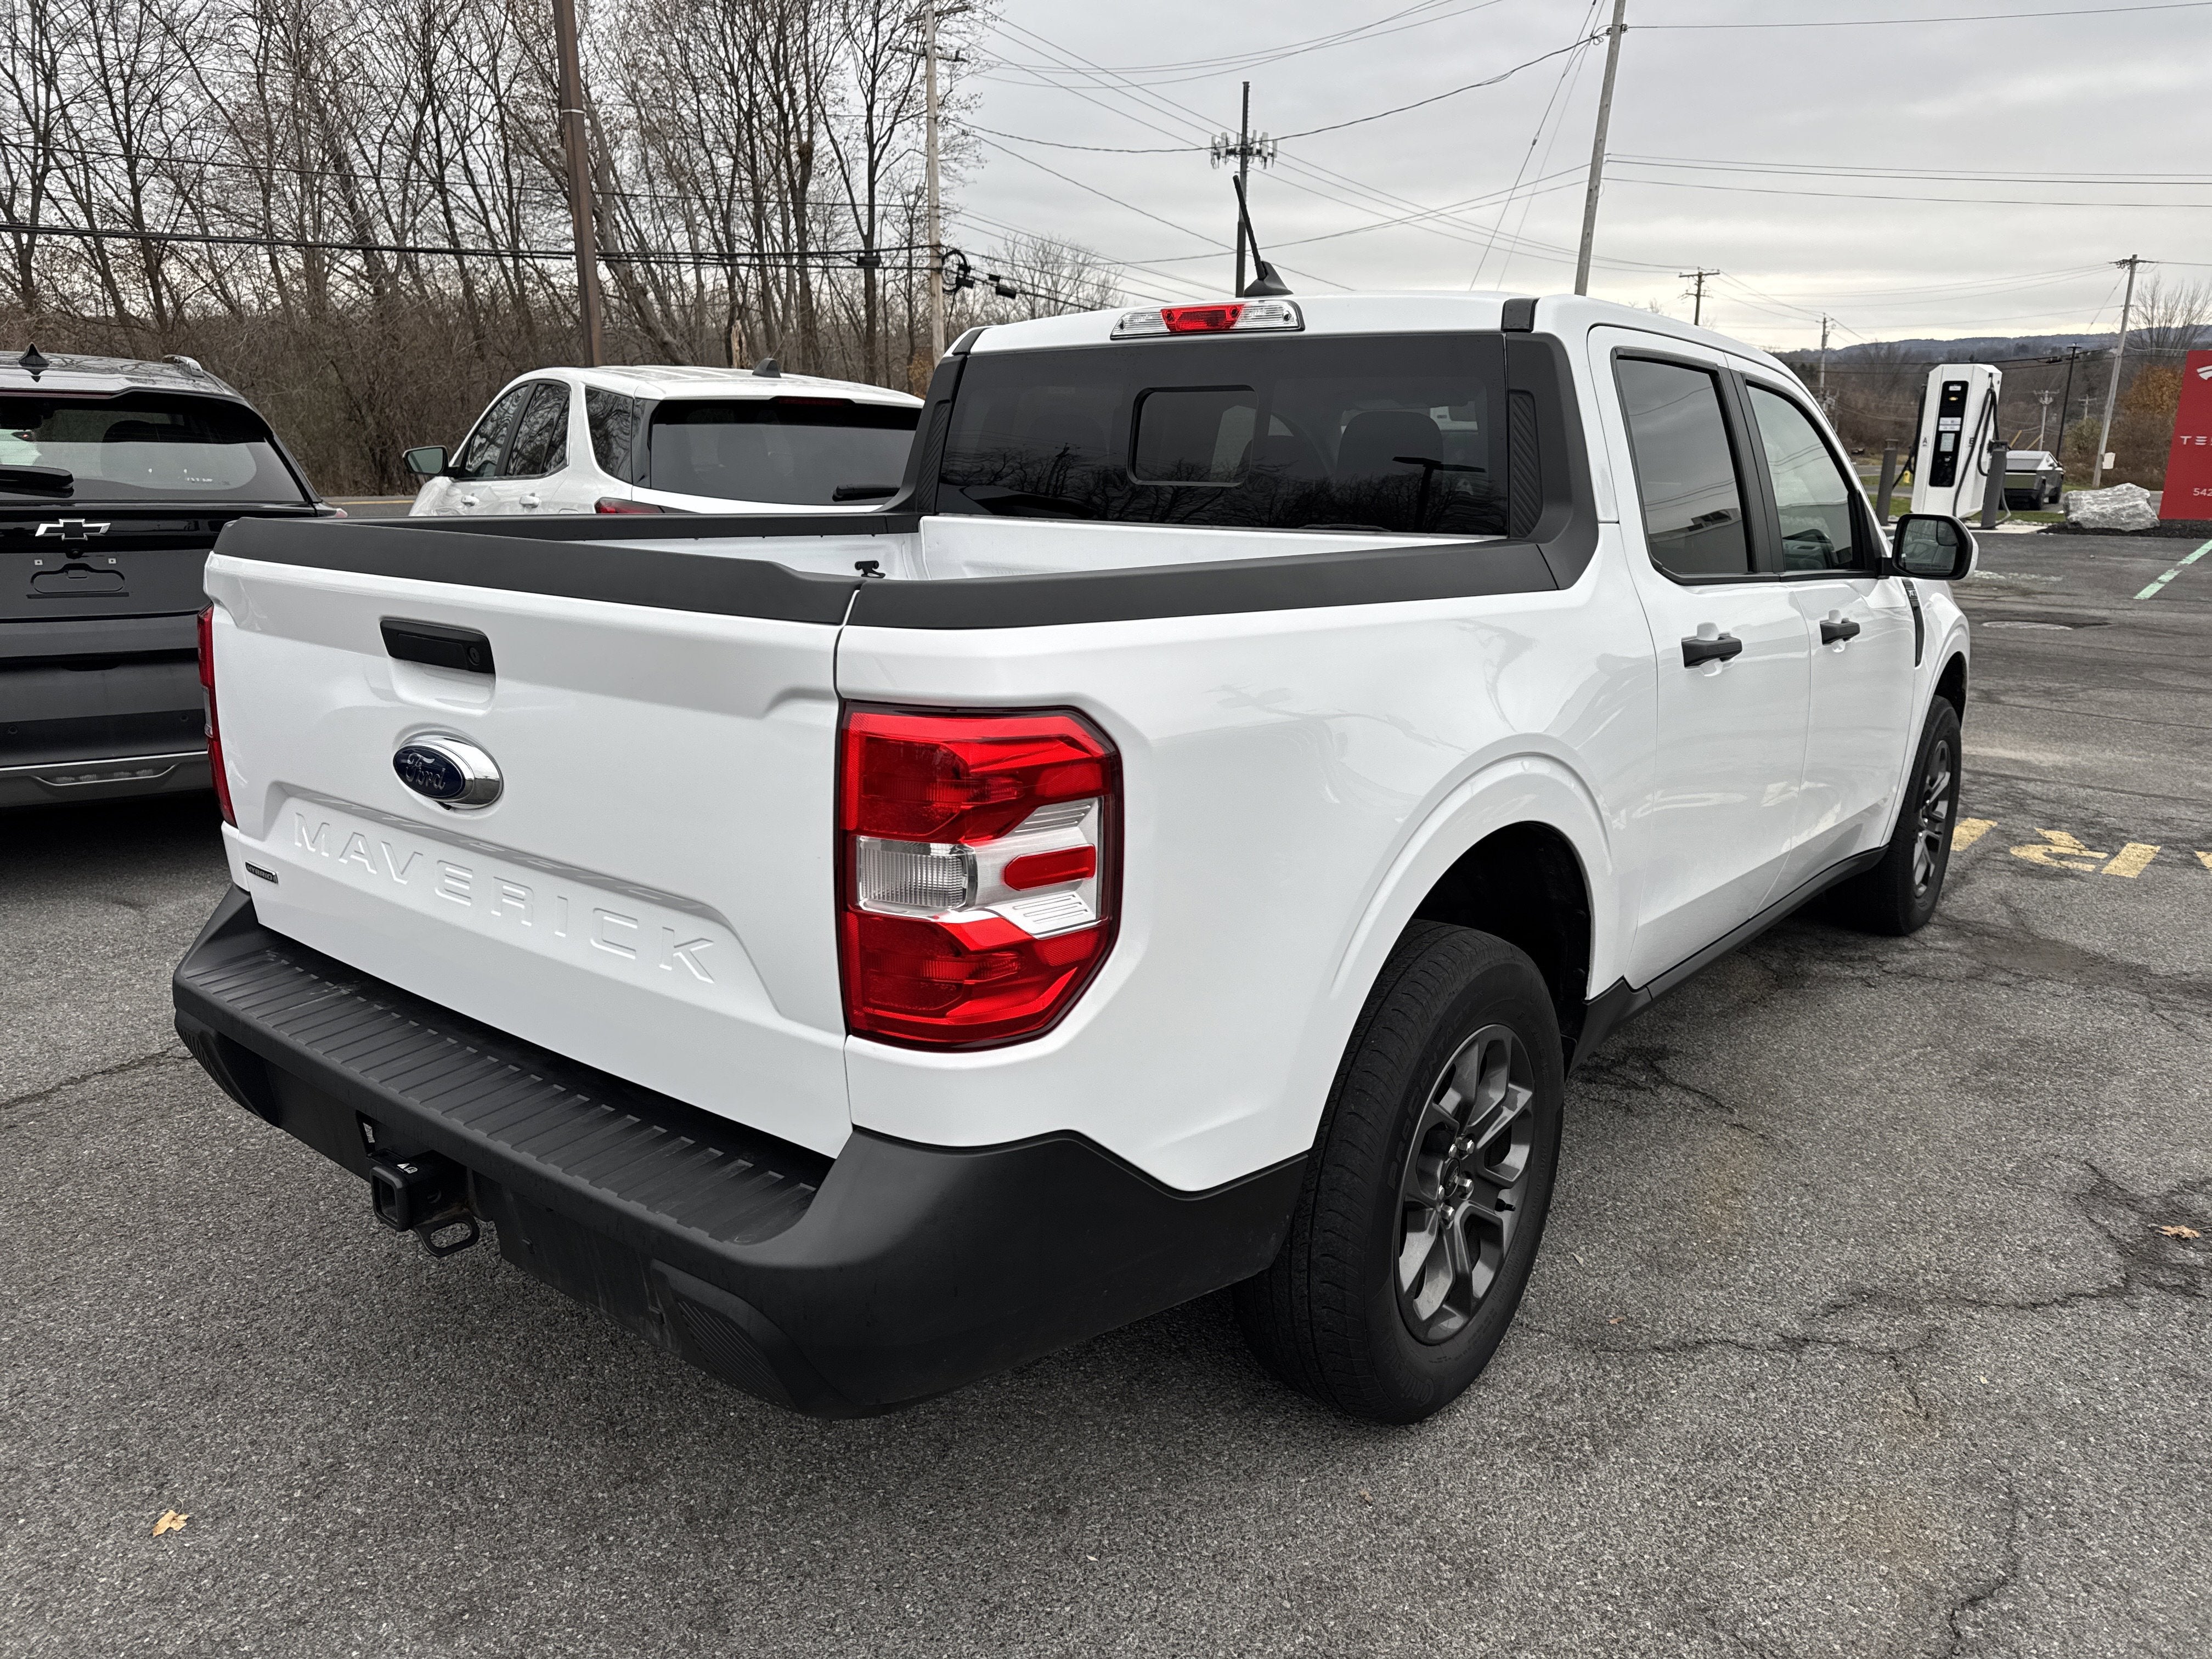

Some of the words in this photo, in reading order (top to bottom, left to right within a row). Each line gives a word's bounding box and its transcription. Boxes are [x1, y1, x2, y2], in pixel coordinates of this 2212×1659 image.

[2180, 436, 2212, 445] TE
[405, 752, 446, 790] Ford
[246, 864, 273, 881] HYBRID
[294, 811, 714, 984] MAVERICK
